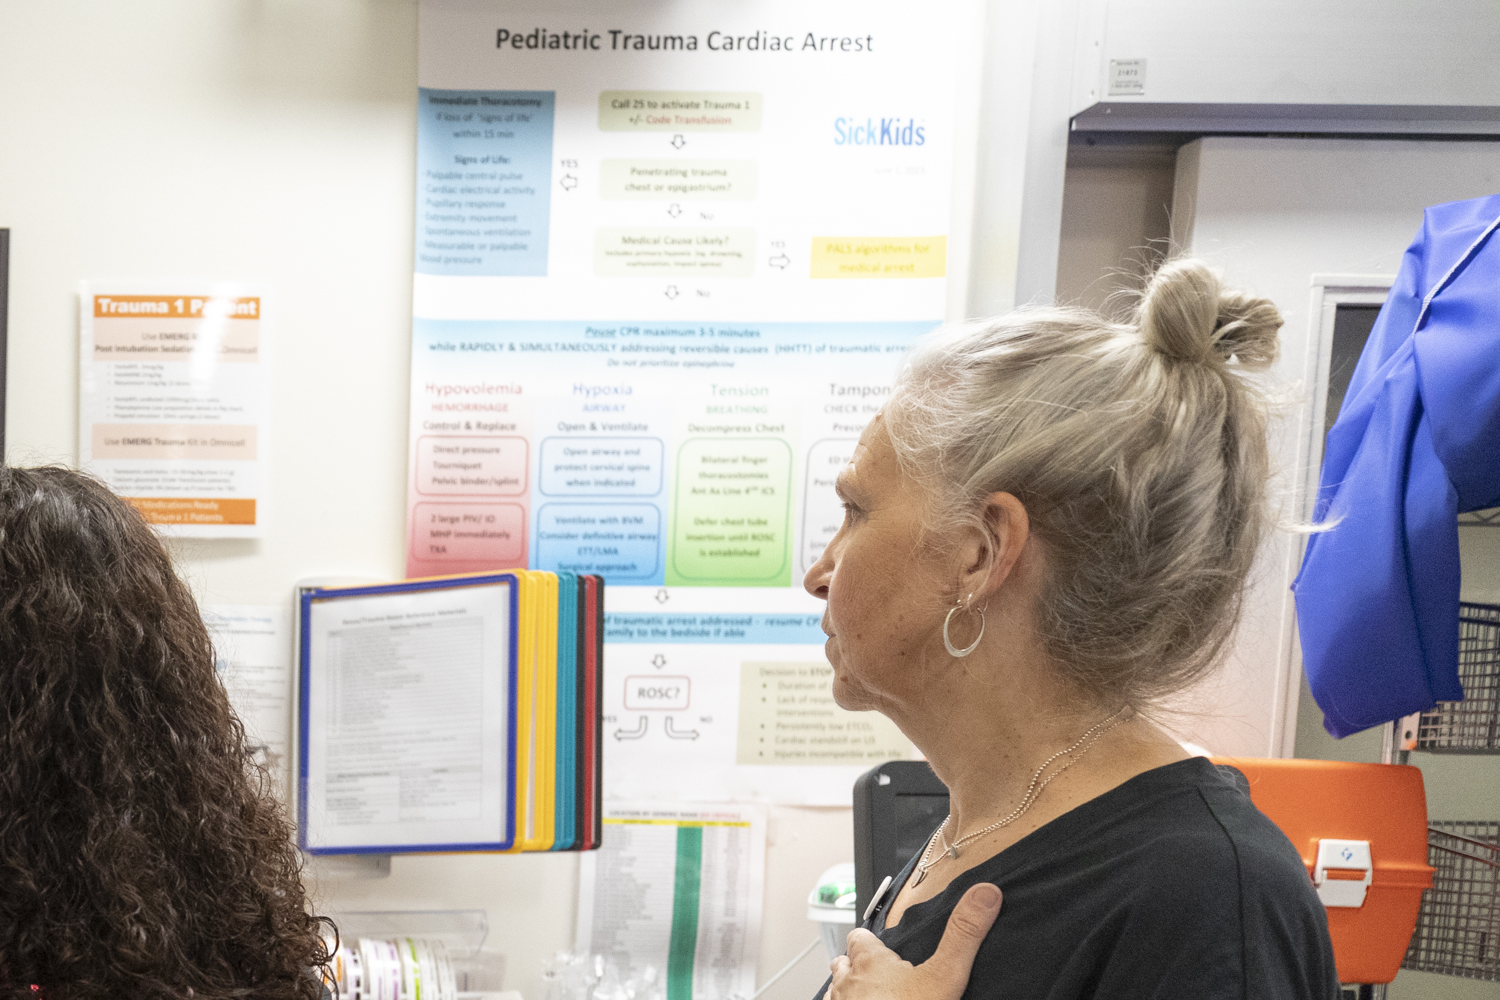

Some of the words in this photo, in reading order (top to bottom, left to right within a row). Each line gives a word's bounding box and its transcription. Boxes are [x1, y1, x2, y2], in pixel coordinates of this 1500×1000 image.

[496, 28, 600, 50] Pediatric
[607, 30, 697, 51] Trauma
[707, 31, 794, 52] Cardiac
[802, 32, 873, 52] Arrest
[612, 99, 630, 109] Call
[633, 100, 644, 109] 25
[647, 100, 658, 109] to
[661, 100, 700, 110] activate
[704, 100, 741, 110] Trauma
[745, 101, 750, 110] 1
[646, 115, 671, 125] Code
[675, 116, 732, 125] Transfusion
[453, 130, 481, 138] within
[484, 130, 494, 138] 15
[834, 118, 925, 145] SickKids
[560, 159, 578, 168] YES
[630, 167, 688, 178] Penetrating
[692, 168, 727, 177] trauma
[625, 183, 651, 191] chest
[622, 236, 660, 245] Medical
[664, 237, 692, 245] Cause
[696, 237, 729, 246] Likely?
[98, 298, 169, 314] Trauma
[174, 299, 184, 314] 1
[586, 327, 616, 338] Pause
[620, 328, 640, 336] CPR
[643, 328, 695, 337] maximum
[718, 329, 761, 338] minutes
[429, 342, 456, 351] while
[460, 342, 504, 351] RAPIDLY
[508, 343, 516, 351] &
[519, 343, 617, 352] SIMULTANEOUSLY
[621, 343, 676, 354] addressing
[680, 343, 730, 353] reversible
[733, 345, 769, 353] causes
[815, 344, 827, 353] of
[830, 344, 881, 353] traumatic
[425, 383, 523, 398] Hypovolemia
[573, 383, 633, 398] Hypoxia
[711, 384, 769, 396] Tension
[830, 384, 891, 398] Tampon
[431, 403, 509, 412] HEMORRHAGE
[582, 403, 626, 412] AIRWAY
[706, 405, 769, 414] BREATHING
[423, 421, 461, 431] Control
[465, 422, 472, 430] &
[476, 421, 517, 433] Replace
[557, 422, 586, 433] Open
[589, 422, 597, 431] &
[601, 422, 648, 431] Ventilate
[688, 423, 752, 435] Decompress
[756, 423, 785, 433] Chest
[637, 687, 681, 700] ROSC?
